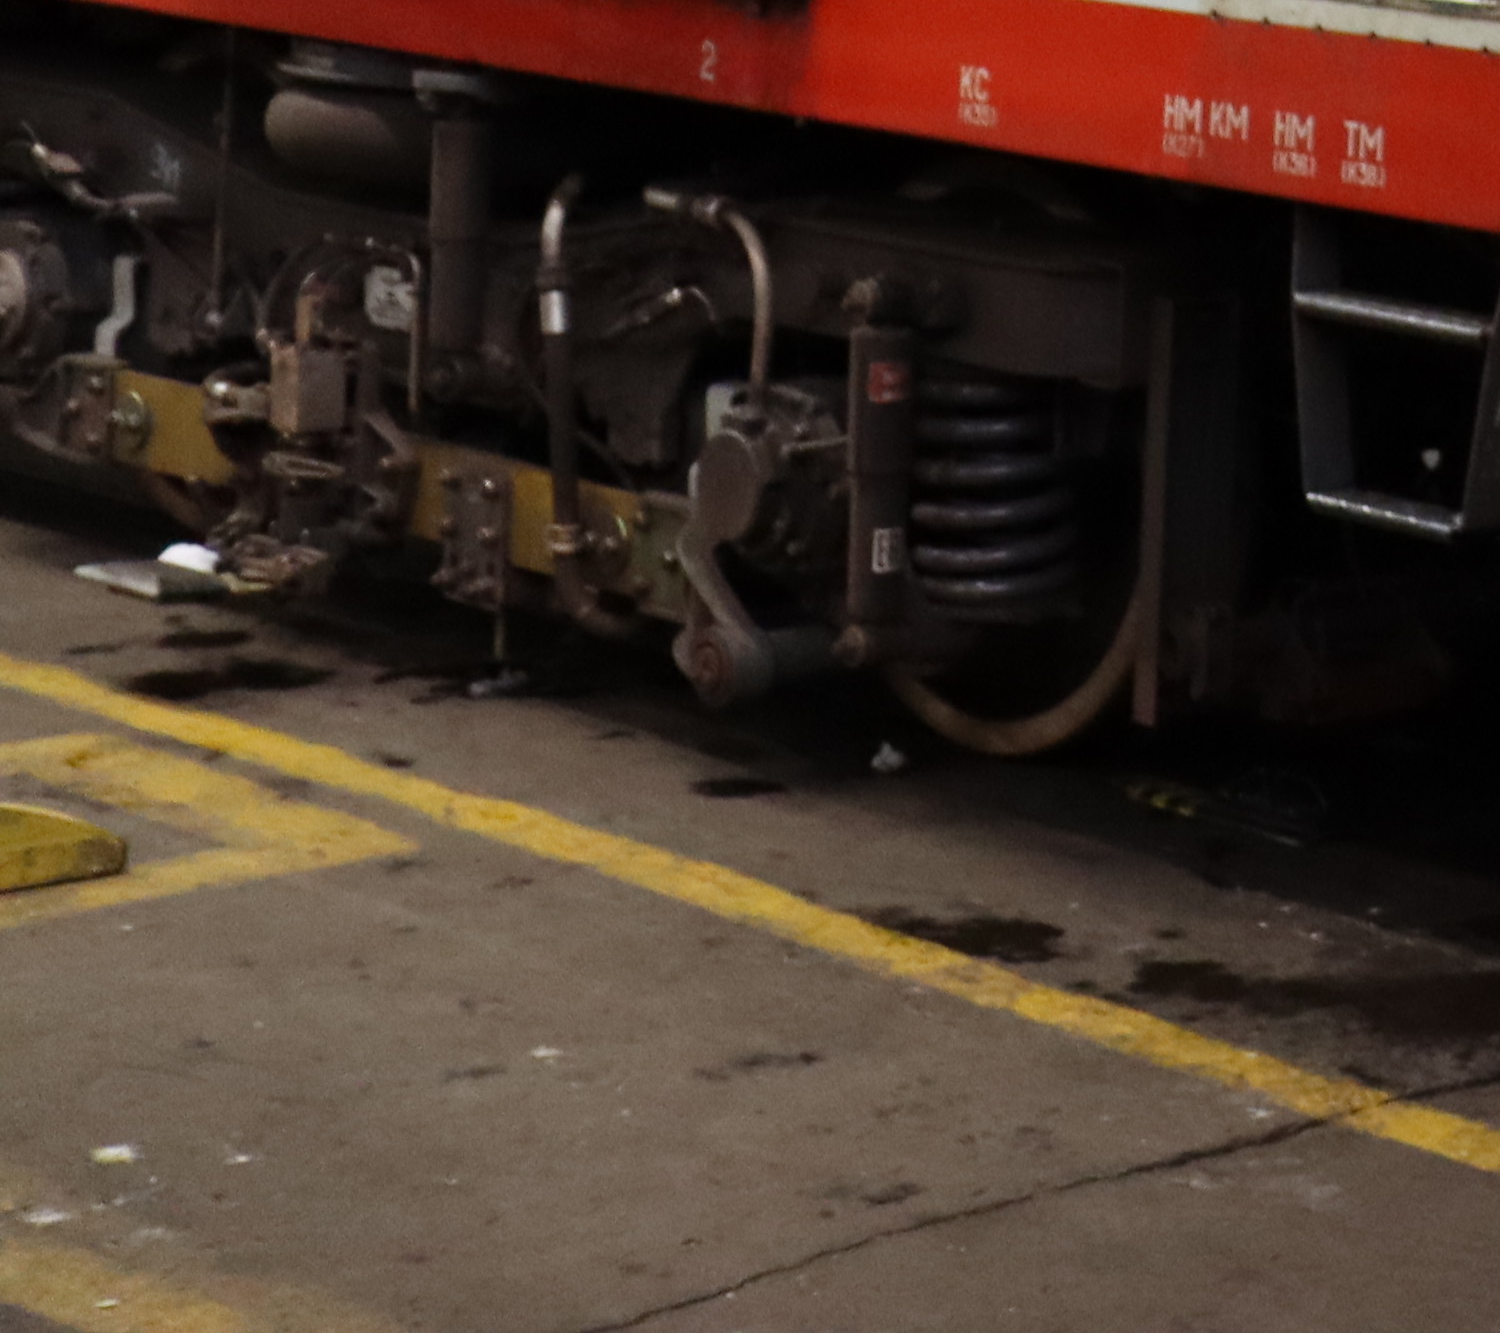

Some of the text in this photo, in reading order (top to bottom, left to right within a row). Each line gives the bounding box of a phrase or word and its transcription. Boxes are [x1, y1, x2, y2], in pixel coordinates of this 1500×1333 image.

[700, 39, 717, 81] 2
[960, 65, 990, 102] КС
[1163, 94, 1384, 162] НМ КМ НМ ТМ
